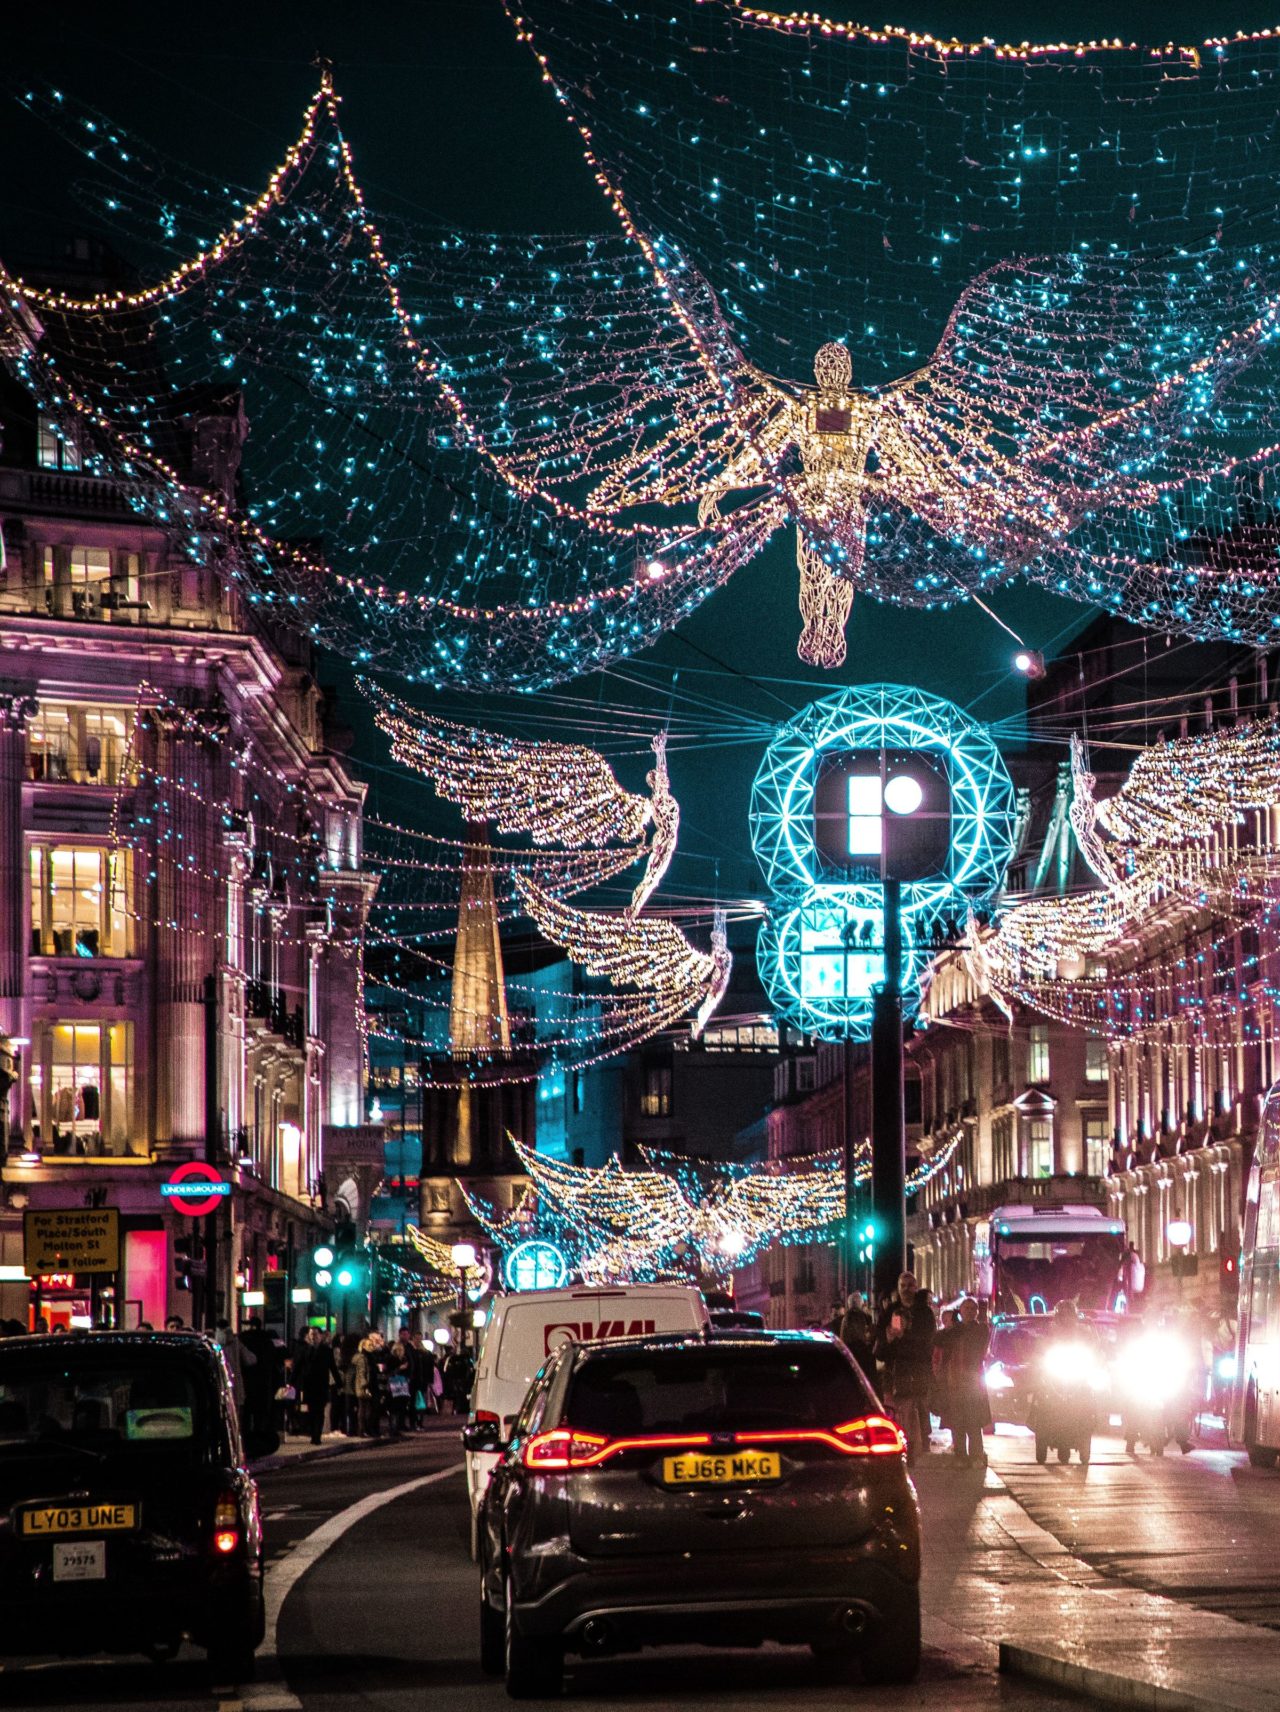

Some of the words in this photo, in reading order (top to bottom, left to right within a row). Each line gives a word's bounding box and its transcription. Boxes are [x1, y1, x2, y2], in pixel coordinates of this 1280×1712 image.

[163, 1185, 226, 1194] UNDERGROUND
[34, 1216, 52, 1226] For
[56, 1213, 109, 1225] Stratford
[37, 1226, 107, 1238] Place/South
[43, 1241, 83, 1251] Molton
[87, 1240, 100, 1249] St
[72, 1257, 107, 1266] follow
[673, 1458, 726, 1479] EJ66
[732, 1456, 771, 1476] MKG
[31, 1510, 82, 1530] LY03
[88, 1508, 126, 1525] UNE
